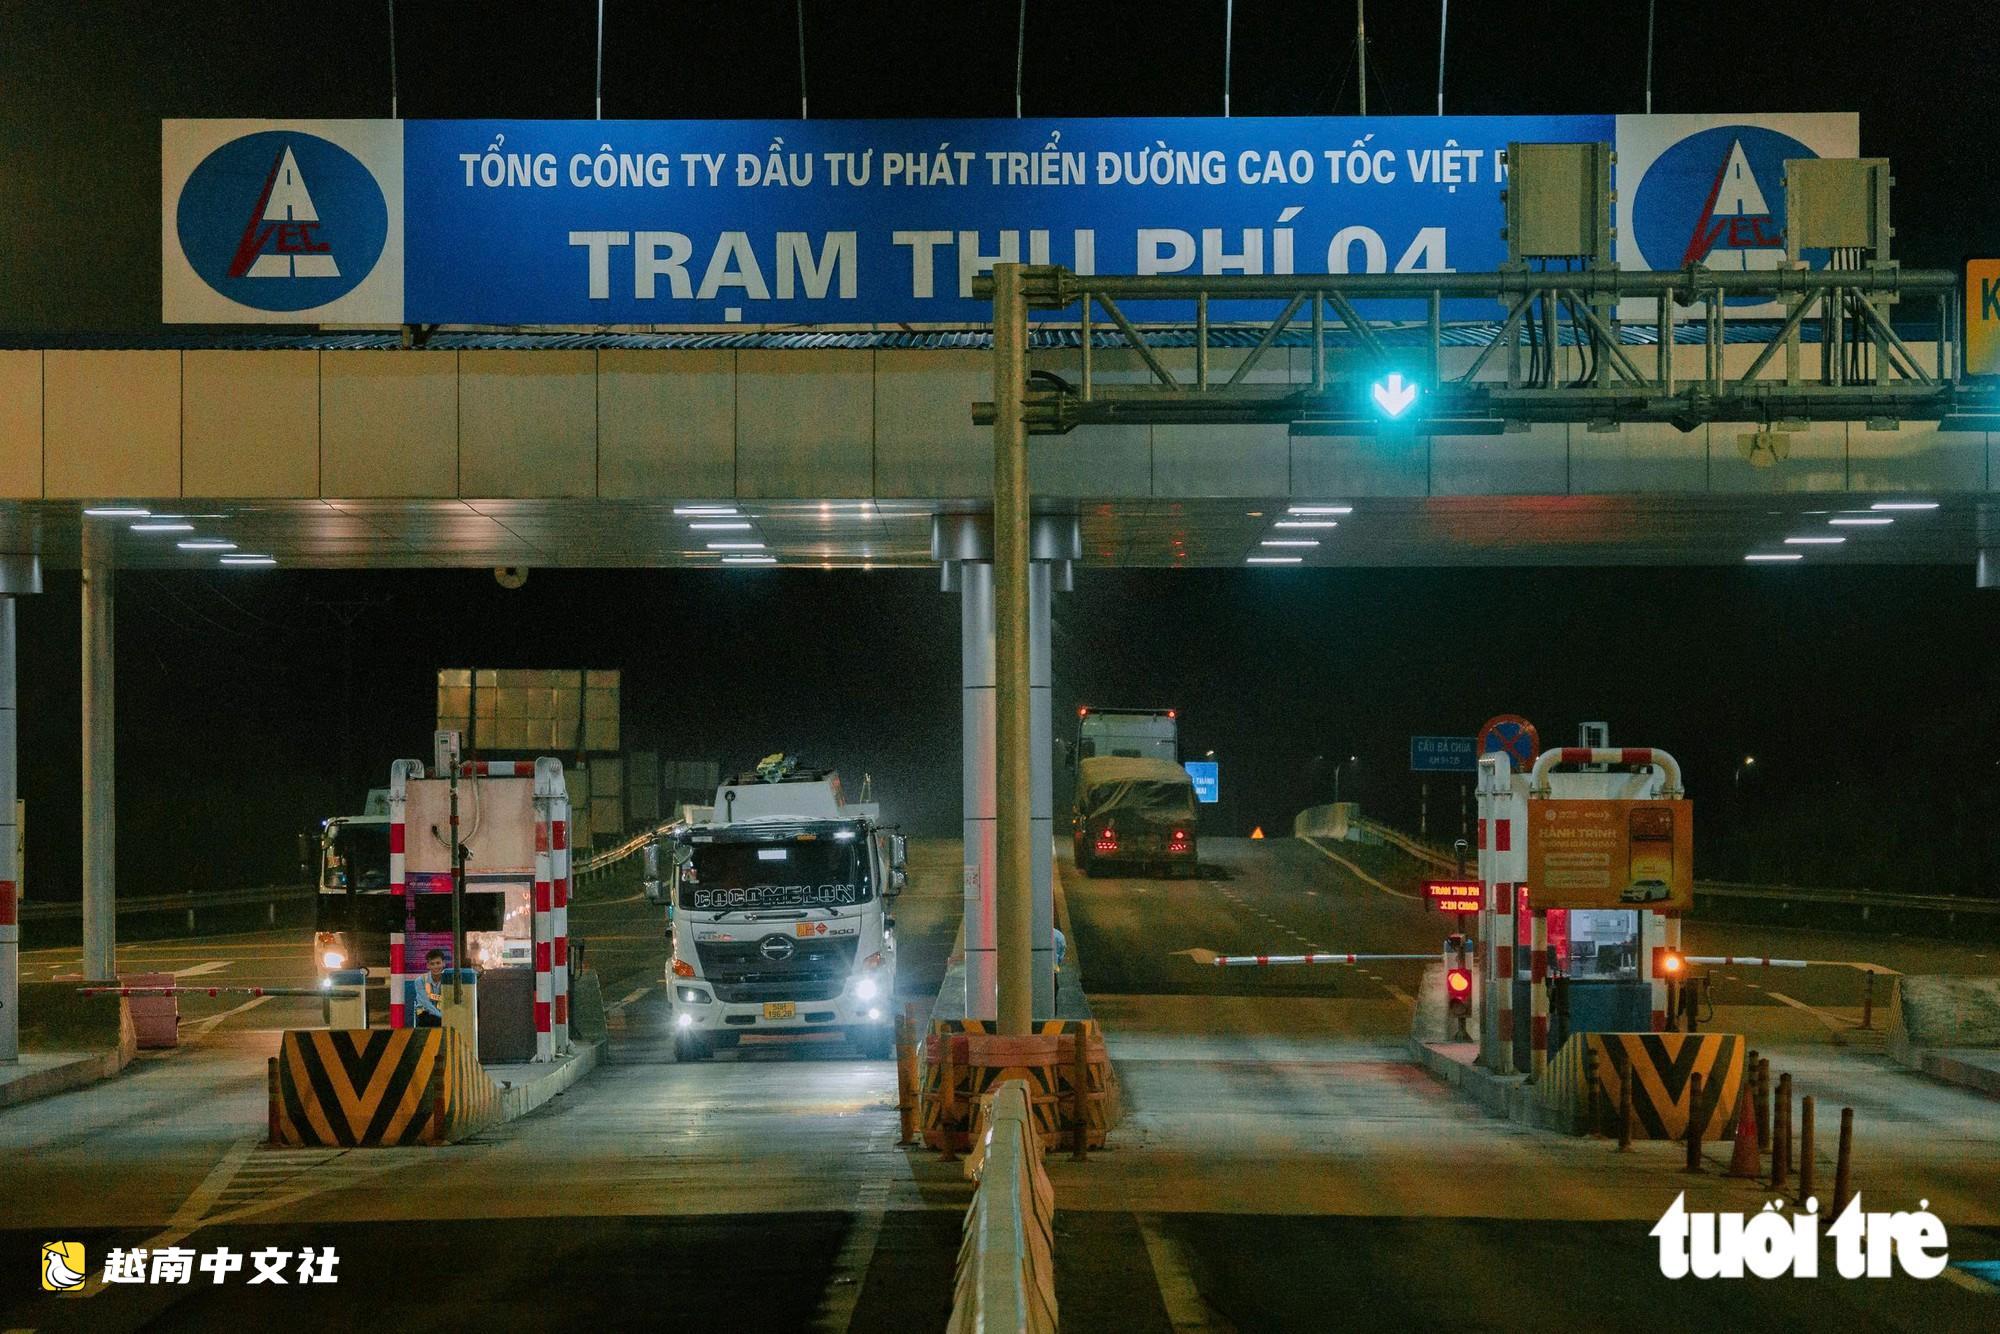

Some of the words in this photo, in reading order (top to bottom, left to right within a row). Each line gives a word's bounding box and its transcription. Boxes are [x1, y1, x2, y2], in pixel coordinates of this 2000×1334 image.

[459, 133, 557, 187] TỔNG
[569, 144, 670, 187] CÔNG
[680, 153, 726, 187] TY
[736, 137, 813, 187] ĐẦU
[824, 148, 873, 186] TƯ
[883, 142, 976, 186] PHÁT
[985, 130, 1086, 185] TRIỂN
[1096, 140, 1226, 185] ĐƯỜNG
[1238, 149, 1314, 184] CAO
[1325, 133, 1396, 184] TỐC
[1406, 139, 1484, 193] VIỆT
[568, 230, 858, 322] TRẠM
[1137, 206, 1305, 275] PHÍ
[1327, 225, 1457, 275] 04
[694, 884, 856, 908] COCOMELON
